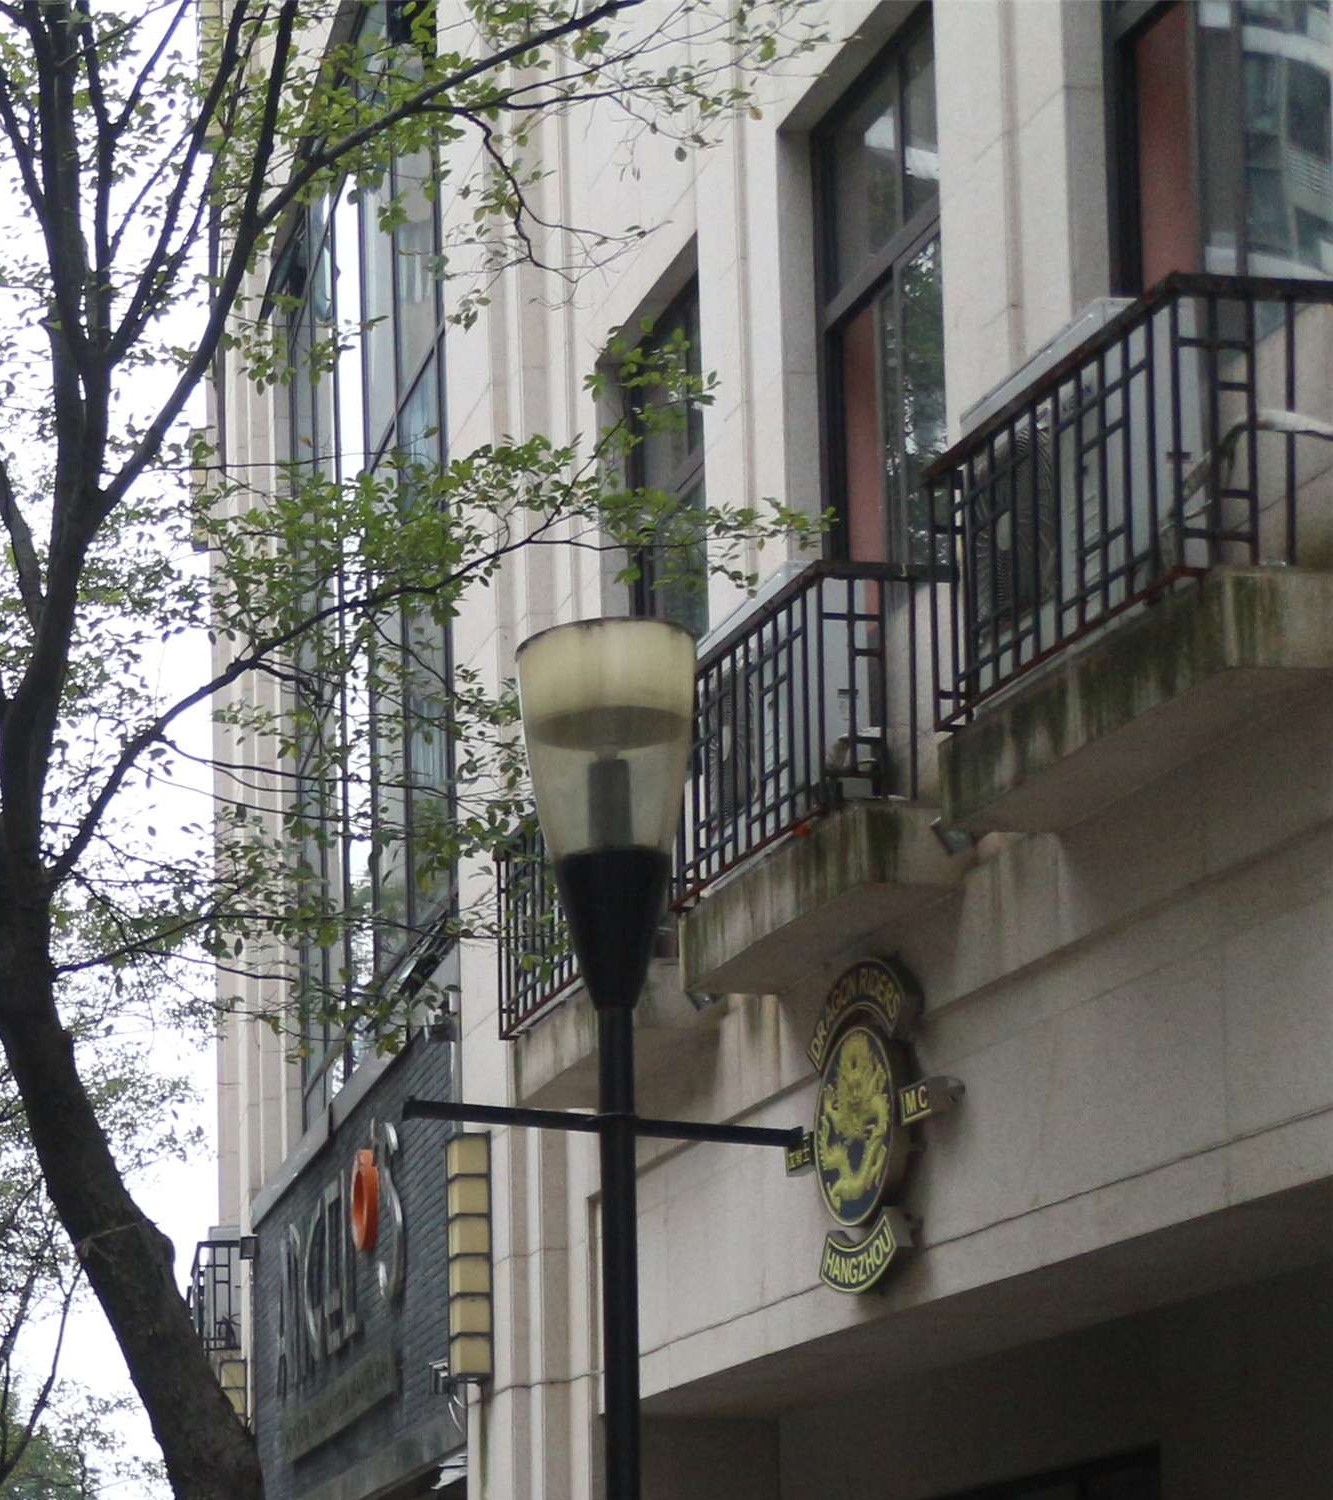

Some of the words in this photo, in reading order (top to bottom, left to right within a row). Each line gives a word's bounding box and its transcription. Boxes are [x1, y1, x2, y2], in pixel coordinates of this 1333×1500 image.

[810, 971, 857, 1060] DRAGON
[905, 1085, 929, 1115] MC
[824, 1229, 893, 1286] HANGZHOU
